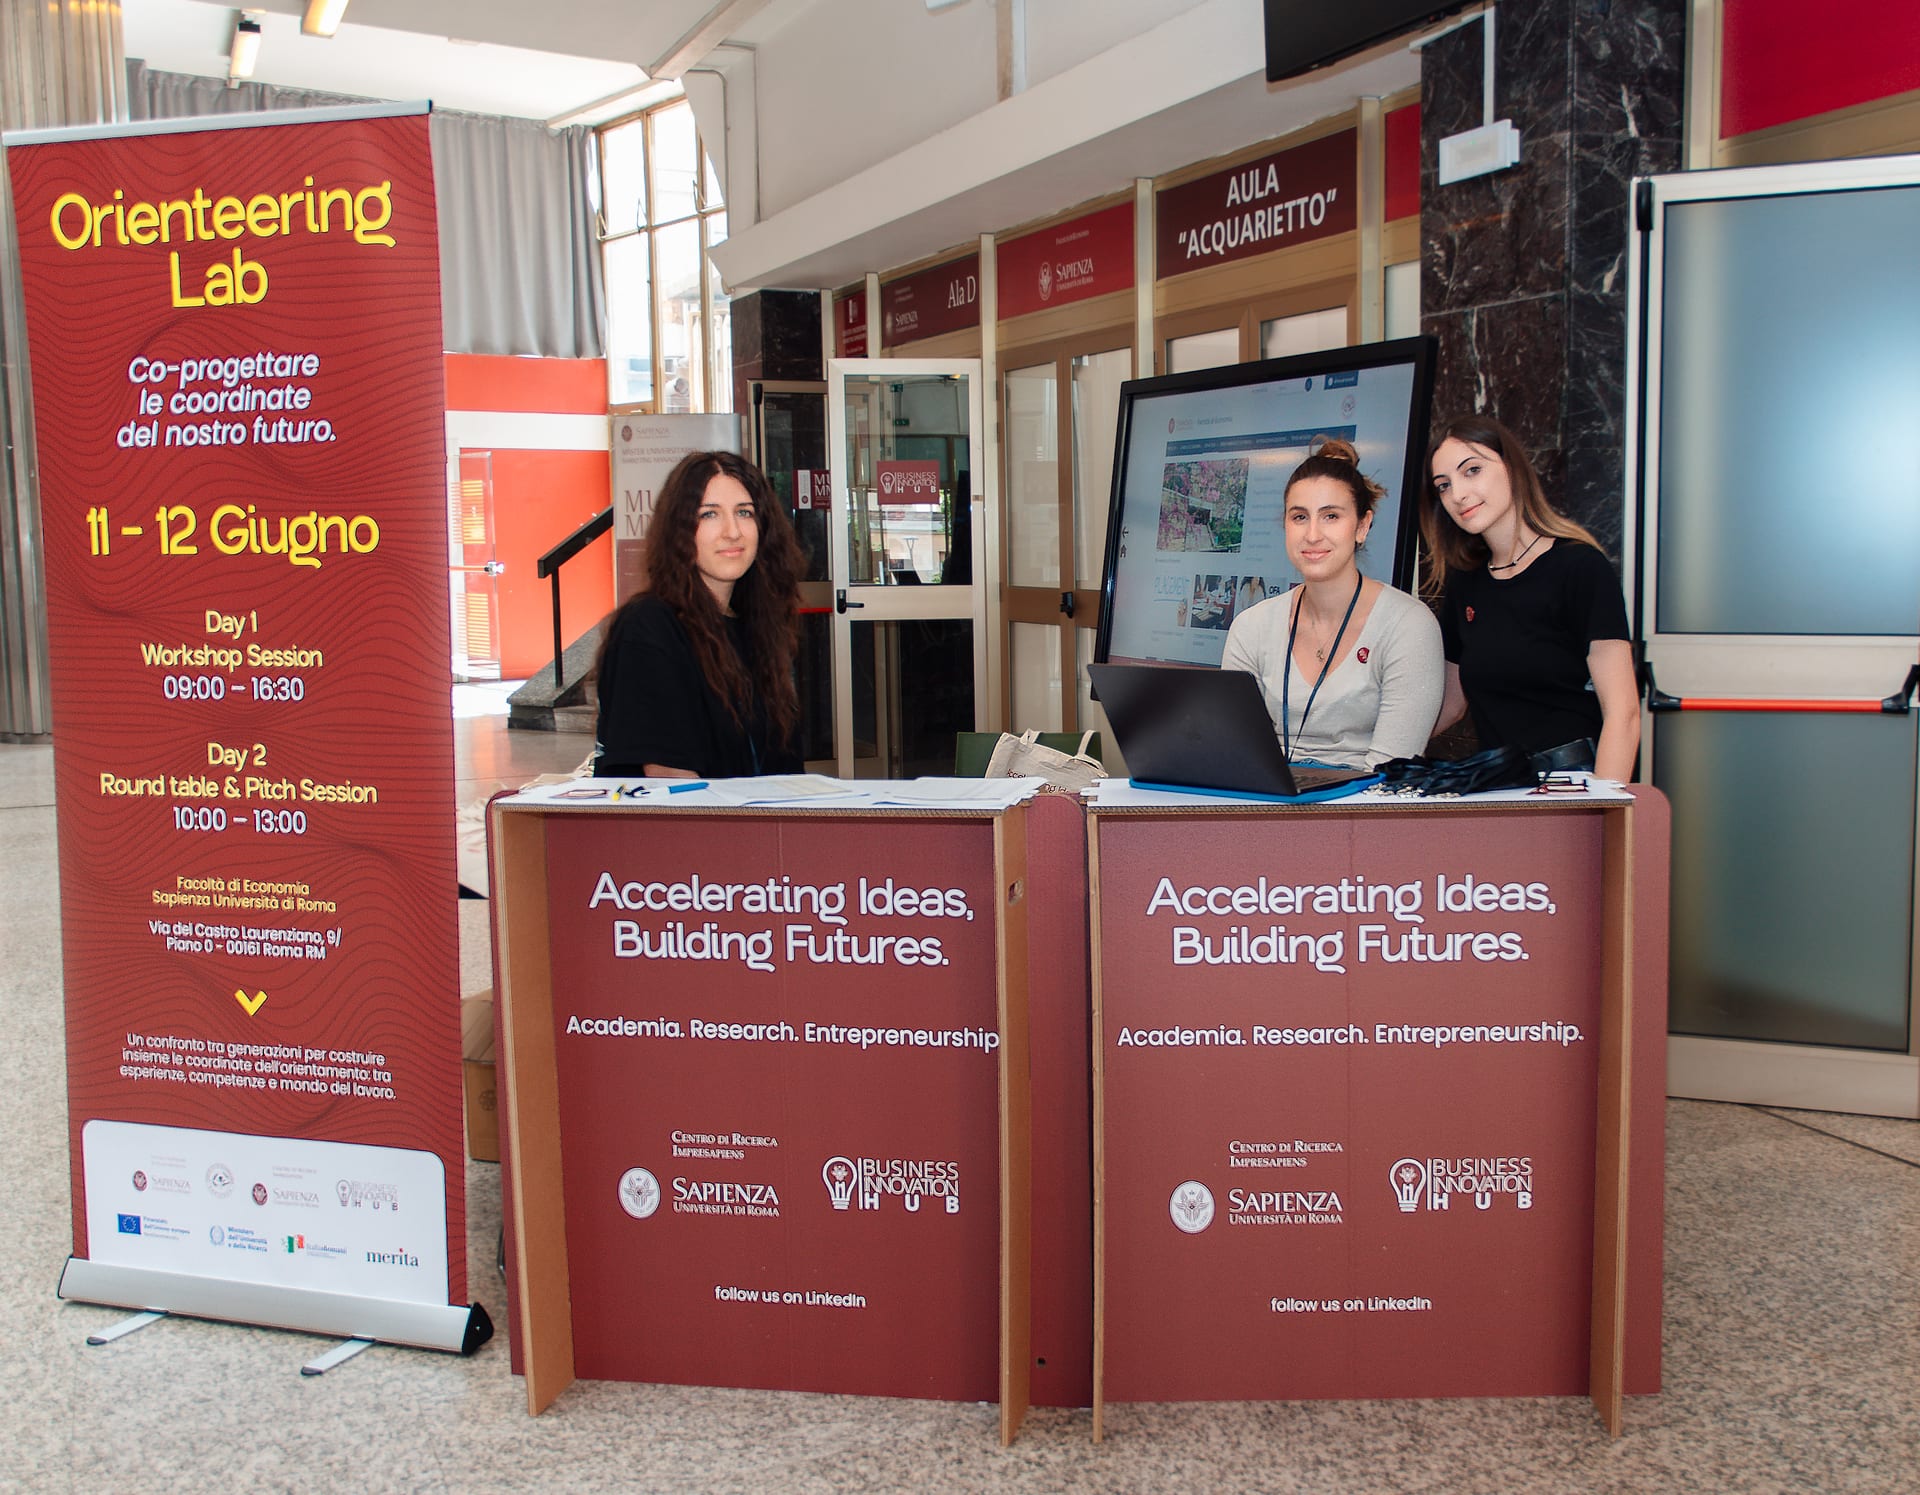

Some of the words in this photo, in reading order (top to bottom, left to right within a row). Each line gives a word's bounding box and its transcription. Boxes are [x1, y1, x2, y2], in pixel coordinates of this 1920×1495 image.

[1226, 163, 1279, 207] AULA
[50, 176, 396, 250] Orienteering
[169, 247, 269, 308] Lab
[1056, 257, 1093, 282] SAPIENZA
[948, 279, 965, 309] Ala
[966, 275, 976, 304] D
[128, 352, 320, 388] Co-progettare
[139, 388, 163, 415] le
[169, 384, 312, 413] coordinate
[117, 421, 158, 448] del
[165, 419, 247, 446] nostro
[252, 416, 337, 443] futuro.
[897, 472, 936, 480] BUSINESS
[86, 507, 110, 556] 11
[155, 505, 198, 555] 12
[209, 504, 380, 569] Giugno
[205, 609, 245, 640] Day
[250, 609, 259, 633] 1
[141, 643, 243, 672] Workshop
[247, 644, 323, 668] Session
[163, 675, 226, 700] 09:00
[251, 676, 305, 701] 16:30
[207, 743, 248, 772] Day
[253, 743, 267, 767] 2
[100, 773, 165, 797] Round
[170, 775, 219, 798] table
[223, 777, 241, 799] &
[245, 777, 296, 801] Pitch
[300, 779, 378, 803] Session
[173, 806, 227, 832] 10:00
[253, 809, 307, 834] 13:00
[177, 876, 225, 892] Facoltà
[227, 878, 241, 893] di
[243, 879, 310, 896] Economia
[589, 872, 849, 926] Accelerating
[859, 876, 975, 921] Ideas,
[1146, 875, 1425, 924] Accelerating
[1436, 874, 1556, 914] Ideas,
[152, 890, 211, 908] Sapienza
[213, 893, 279, 910] Università
[281, 896, 295, 911] di
[297, 898, 337, 913] Roma
[149, 920, 171, 935] Via
[173, 921, 193, 936] del
[195, 923, 239, 939] Castro
[242, 925, 325, 945] Laurenziano,
[613, 920, 776, 972] Building
[785, 924, 950, 966] Futures.
[166, 936, 203, 952] Piano
[226, 940, 261, 956] 00161
[263, 943, 303, 960] Roma
[305, 944, 326, 960] RM
[1173, 926, 1346, 974] Building
[1358, 924, 1529, 962] Futures.
[566, 1015, 685, 1039] Academia.
[690, 1018, 799, 1042] Research.
[805, 1023, 1000, 1053] Entrepreneurship
[1117, 1025, 1247, 1047] Academia.
[1253, 1024, 1369, 1045] Research.
[1375, 1021, 1585, 1048] Entrepreneurship.
[126, 1032, 144, 1047] Un
[146, 1035, 205, 1052] confronto
[207, 1039, 225, 1054] tra
[227, 1043, 302, 1060] generazioni
[304, 1046, 326, 1063] per
[329, 1050, 385, 1067] costruire
[122, 1047, 170, 1065] insieme
[171, 1051, 184, 1066] le
[185, 1054, 252, 1072] coordinate
[373, 1068, 392, 1083] tra
[120, 1064, 187, 1084] esperienze,
[189, 1070, 266, 1090] competenze
[268, 1077, 278, 1089] e
[280, 1076, 328, 1094] mondo
[330, 1081, 351, 1096] del
[353, 1083, 397, 1100] lavoro.
[863, 1158, 959, 1180] BUSINESS
[1432, 1157, 1533, 1177] BUSINESS
[672, 1177, 779, 1205] SAPIENZA
[864, 1176, 959, 1197] INNOVATION
[1433, 1175, 1532, 1193] INNOVATION
[747, 1205, 779, 1217] ROMA
[1229, 1188, 1343, 1213] SAPIENZA
[1309, 1213, 1343, 1225] ROMA
[367, 1248, 419, 1267] merita
[715, 1286, 759, 1301] follow
[762, 1290, 779, 1304] us
[783, 1291, 802, 1305] on
[805, 1290, 866, 1308] LinkedIn
[1271, 1297, 1318, 1312] follow
[1322, 1298, 1340, 1312] us
[1344, 1297, 1364, 1312] on
[1368, 1296, 1432, 1312] LinkedIn
